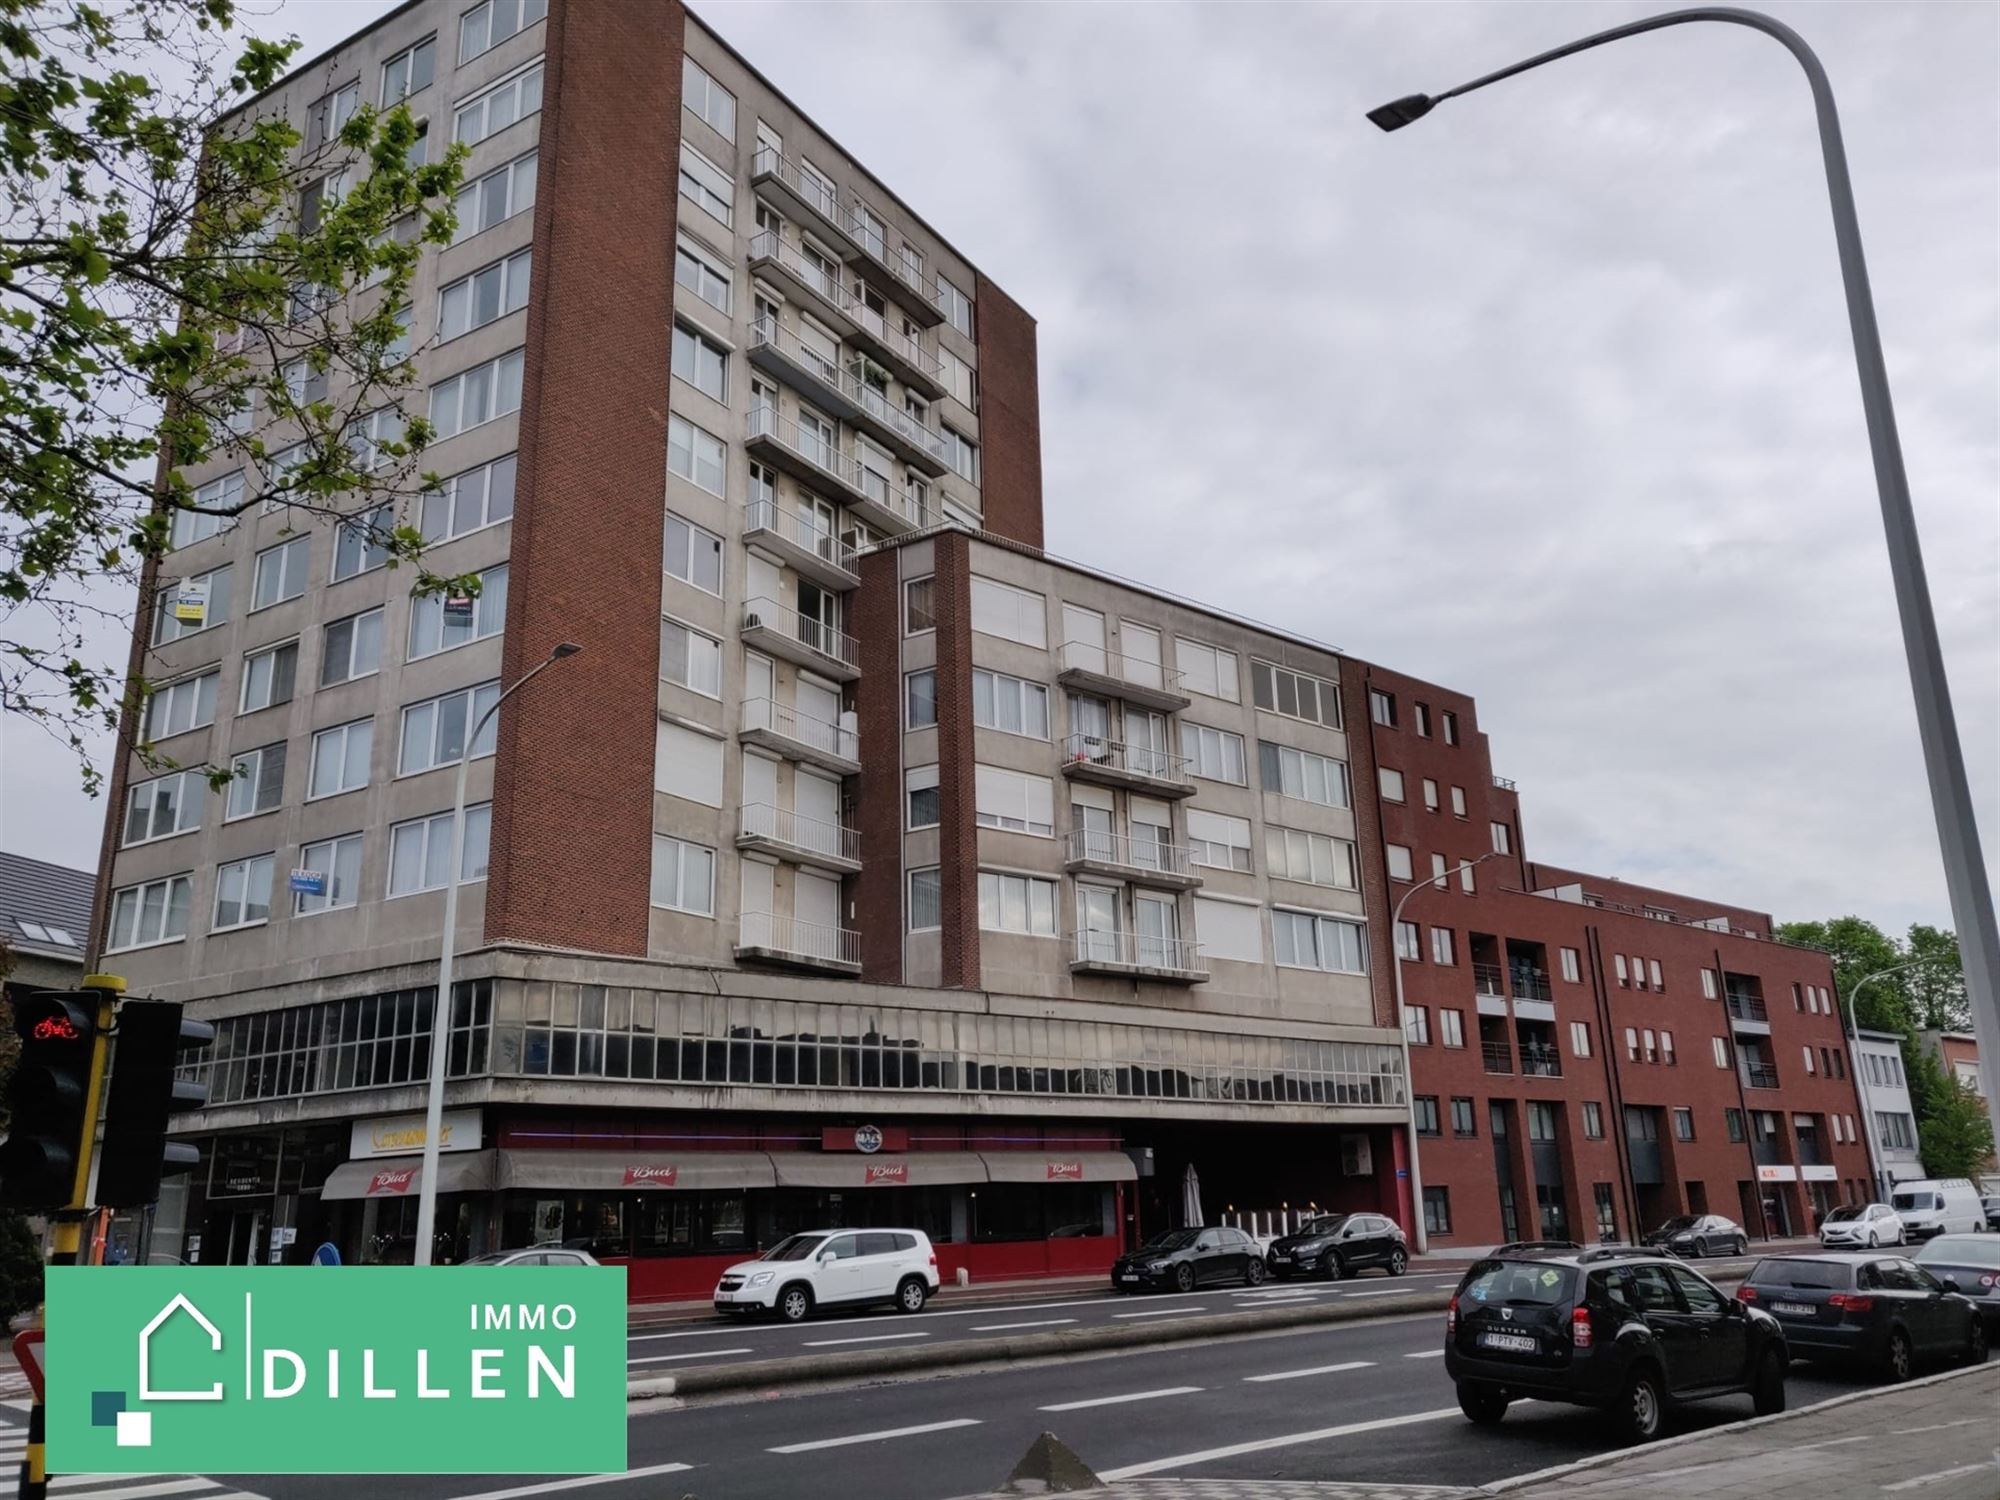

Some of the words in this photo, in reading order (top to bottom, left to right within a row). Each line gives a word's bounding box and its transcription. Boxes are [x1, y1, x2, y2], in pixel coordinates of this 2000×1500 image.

[629, 1166, 673, 1178] Bud
[869, 1165, 904, 1177] Bud
[1050, 1163, 1078, 1173] Bud
[376, 1171, 408, 1186] Bud
[1487, 1325, 1528, 1335] DUSTER
